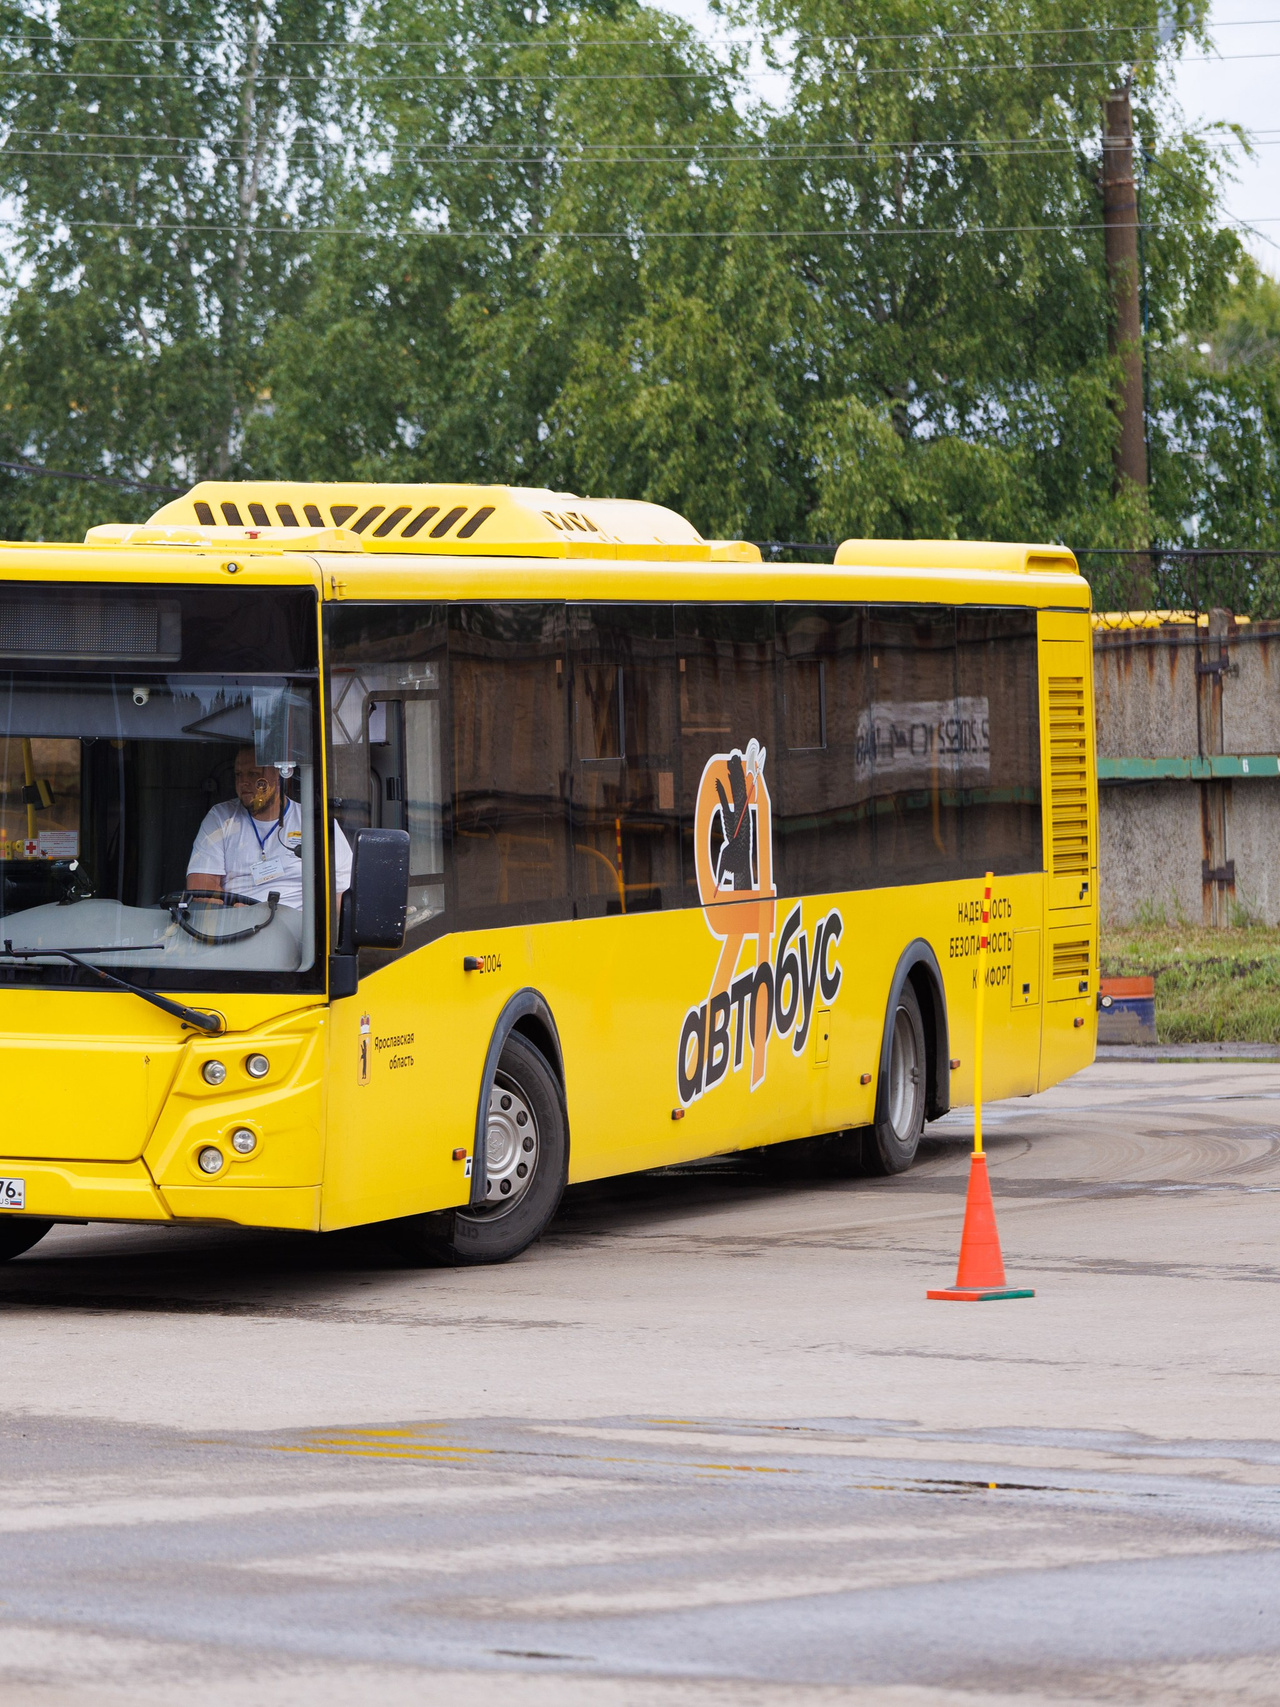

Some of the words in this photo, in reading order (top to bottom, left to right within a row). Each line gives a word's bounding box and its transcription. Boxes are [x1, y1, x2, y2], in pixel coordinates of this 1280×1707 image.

[949, 931, 1012, 958] БЕЗОПАНОСТЬ
[972, 964, 1011, 989] КМФОРТ
[374, 1032, 415, 1053] Ярославская
[389, 1054, 415, 1070] область
